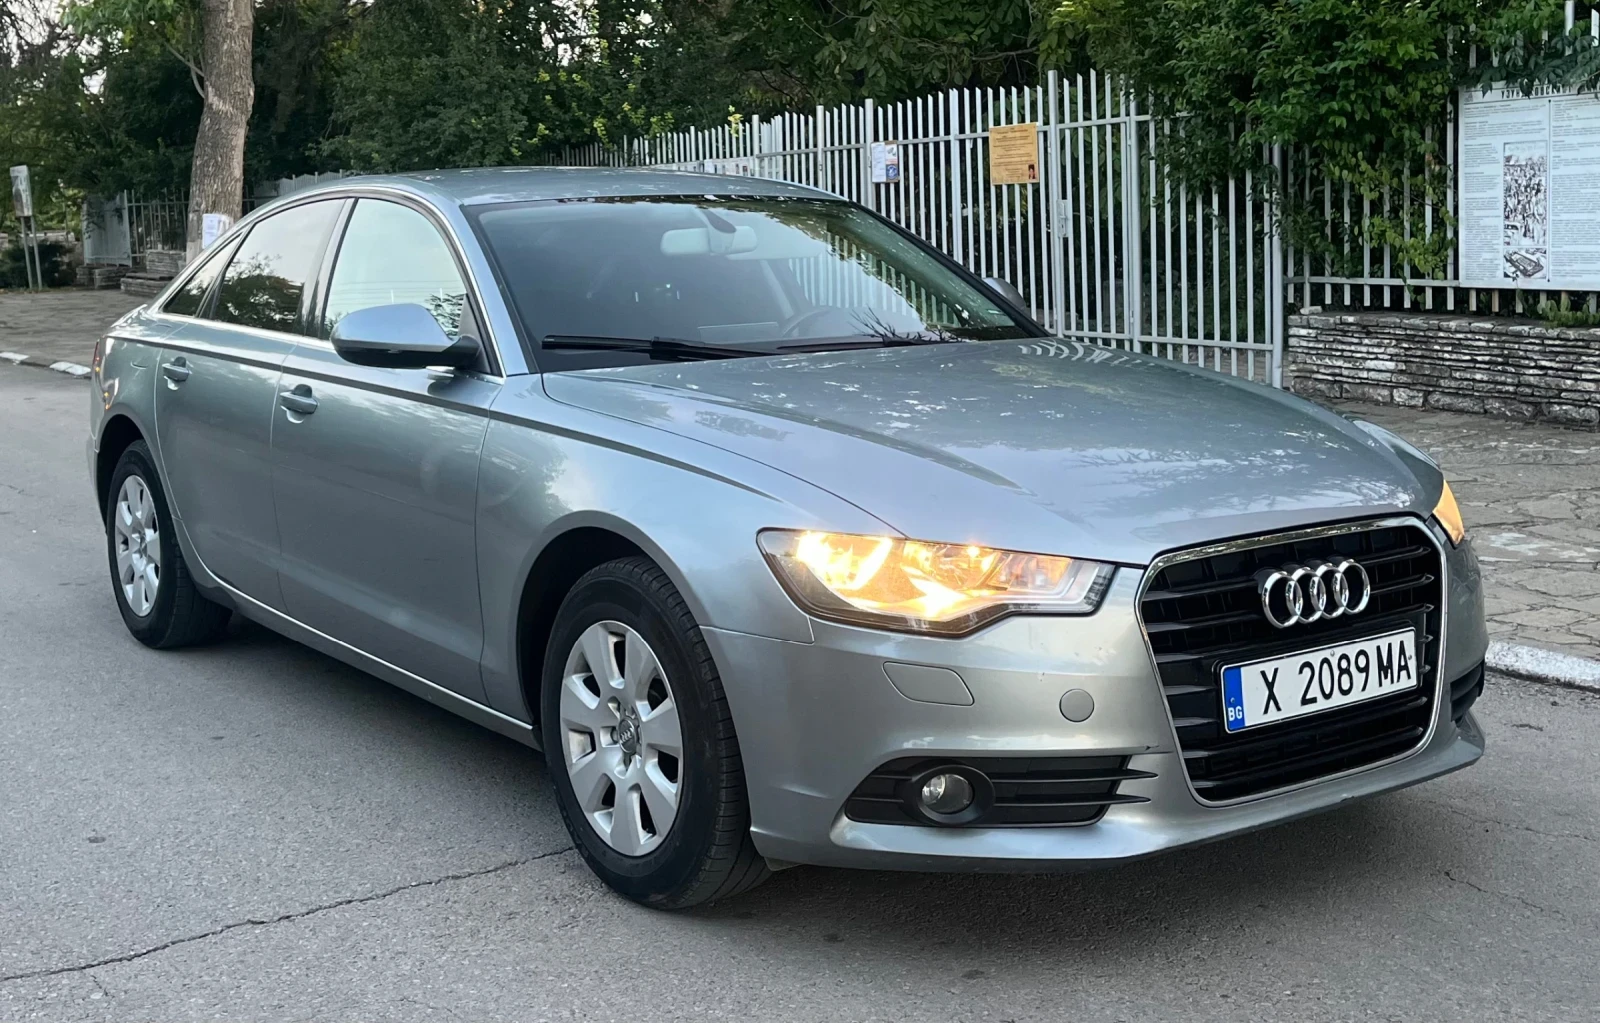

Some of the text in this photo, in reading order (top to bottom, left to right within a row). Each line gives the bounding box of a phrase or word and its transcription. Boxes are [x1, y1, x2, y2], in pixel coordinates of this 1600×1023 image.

[1260, 640, 1411, 715] X 2089 MA
[1228, 705, 1243, 721] BG
